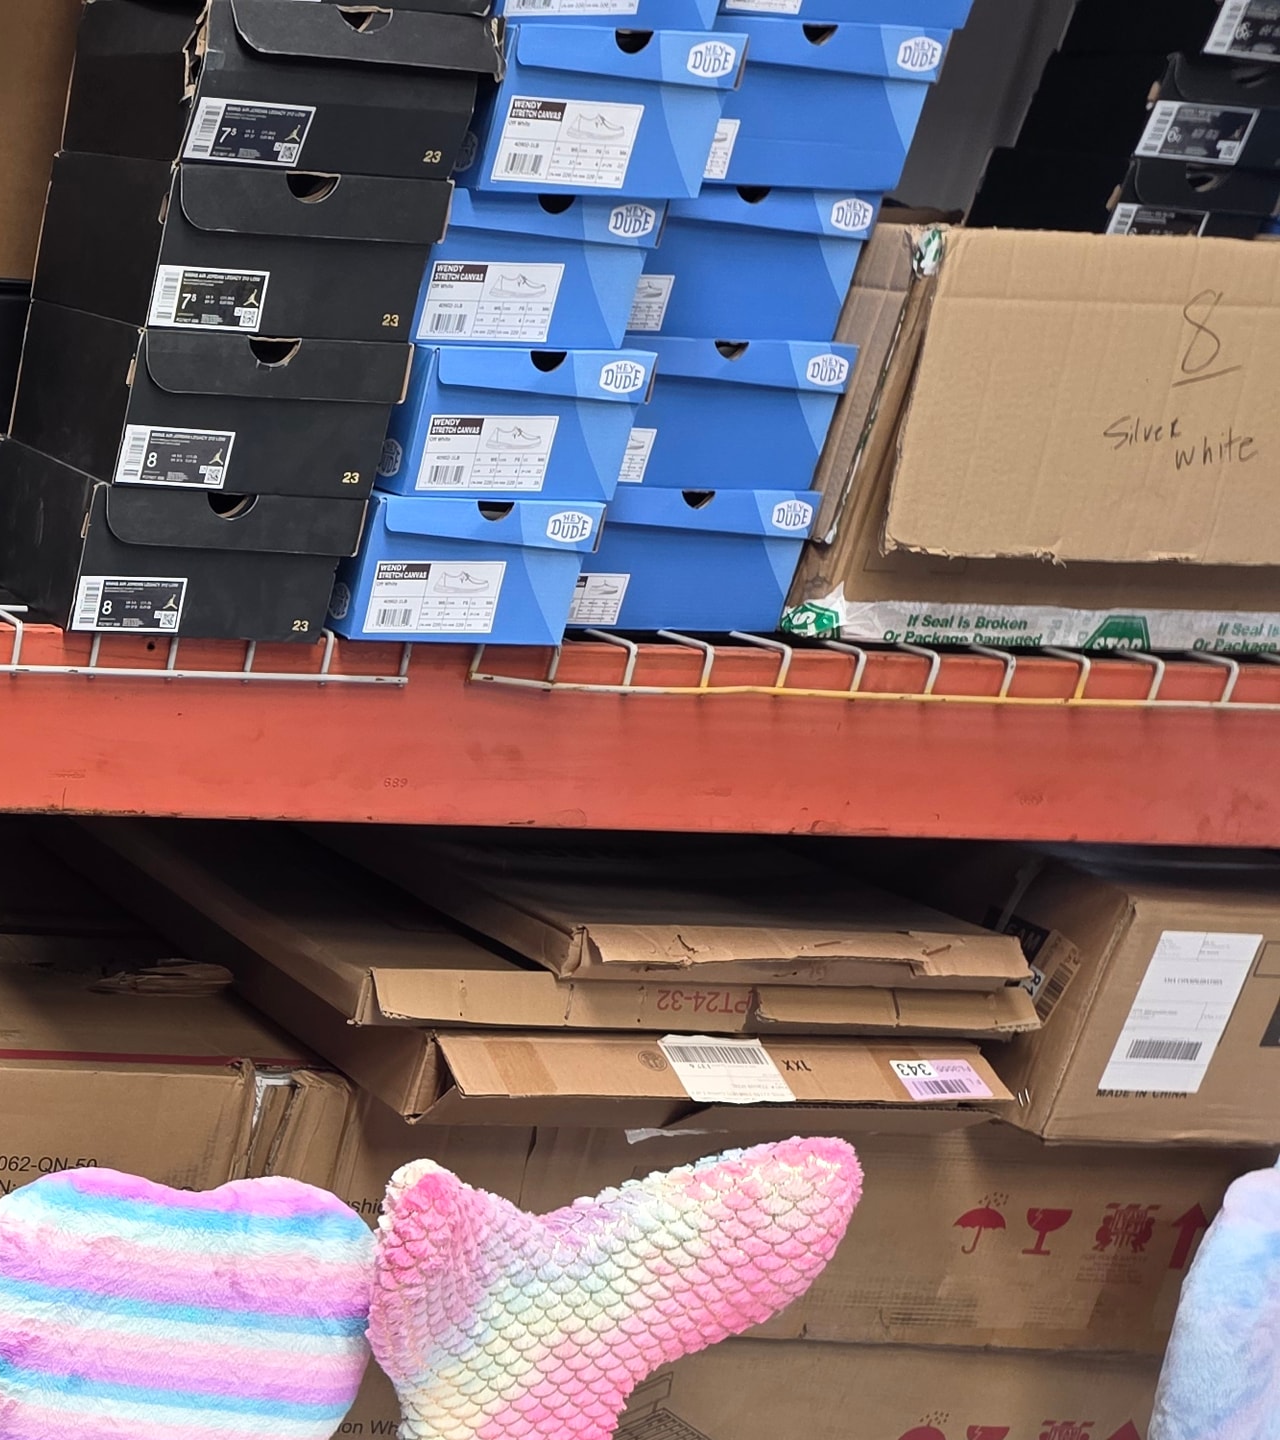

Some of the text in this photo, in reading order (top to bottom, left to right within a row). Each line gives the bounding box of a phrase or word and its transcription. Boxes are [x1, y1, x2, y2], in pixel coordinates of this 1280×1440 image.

[705, 45, 726, 56] HEY
[914, 40, 932, 51] HEY
[901, 45, 938, 67] DUDE
[691, 51, 731, 74] DUDE
[513, 101, 542, 109] WENDY
[511, 109, 562, 120] STRETCH CANVAS
[422, 151, 442, 163] 23
[625, 206, 646, 218] HEY
[846, 201, 863, 211] HEY
[835, 206, 870, 227] DUDE
[613, 212, 651, 234] DUDE
[436, 265, 465, 273] WENDY
[434, 272, 484, 282] STRETCH CANVAS
[381, 314, 400, 326] 23
[1181, 288, 1224, 375] 8
[616, 364, 635, 374] HEY
[822, 358, 839, 368] HEY
[810, 362, 845, 383] DUDE
[605, 369, 641, 390] DUDE
[433, 418, 460, 426] WENDY
[431, 426, 480, 434] STRETCH CANVAS
[146, 452, 158, 467] 8
[342, 472, 360, 484] 23
[563, 514, 583, 524] HEY
[776, 507, 809, 527] DUDE
[551, 519, 589, 540] DUDE
[380, 564, 407, 572] WENDY
[378, 571, 427, 580] STRETCH CANVAS
[102, 600, 112, 615] 8
[292, 620, 309, 632] 23
[907, 614, 1028, 630] If Seal Is Broken
[883, 630, 1043, 646] Or Package Damaged
[1193, 638, 1277, 652] Or Package
[657, 990, 750, 1013] PT24-32
[896, 1062, 932, 1076] 343
